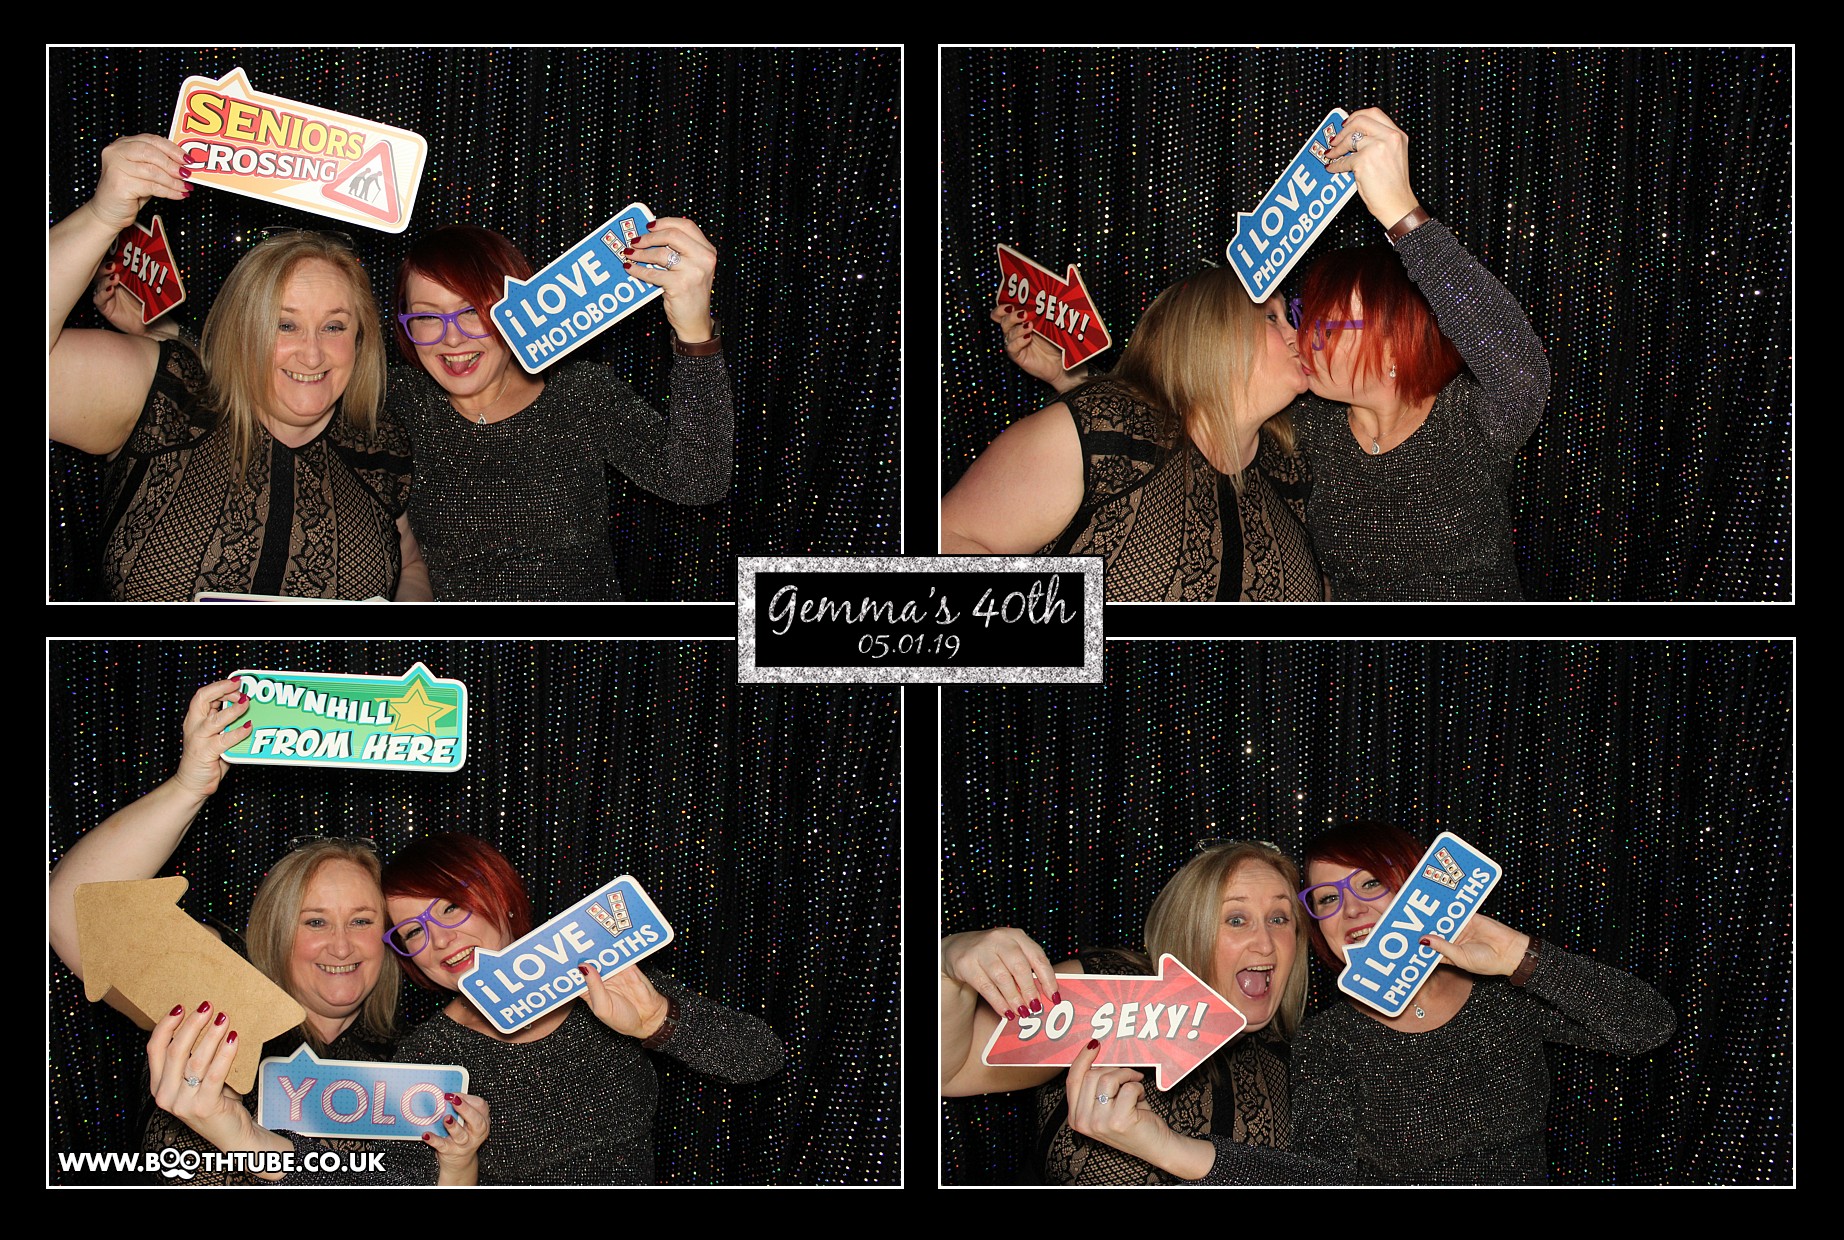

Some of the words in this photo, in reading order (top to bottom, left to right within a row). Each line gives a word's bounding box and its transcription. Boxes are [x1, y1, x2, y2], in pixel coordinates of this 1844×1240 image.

[185, 92, 364, 160] SENIORS
[180, 141, 339, 181] CROSSING
[1237, 243, 1255, 268] i
[1248, 163, 1318, 254] LOVE
[1252, 172, 1352, 290] PHOTOBOOT
[122, 241, 169, 295] SEXY!
[504, 309, 527, 338] i
[519, 250, 611, 328] LOVE
[525, 264, 654, 363] PHOTOBOOT
[1008, 272, 1030, 305] SO
[1035, 289, 1091, 341] SEXY!
[239, 675, 395, 725] DOWNHILL
[250, 728, 352, 760] FROM
[361, 733, 459, 764] HERE
[474, 979, 502, 1004] i
[493, 921, 596, 994] LOVE
[1364, 888, 1441, 977] LOVE
[1382, 867, 1491, 1006] PHOTOOOTHS
[1352, 973, 1381, 992] i
[1018, 1000, 1075, 1040] SO
[1089, 1001, 1209, 1040] SEXY!
[277, 1075, 447, 1126] YOLO
